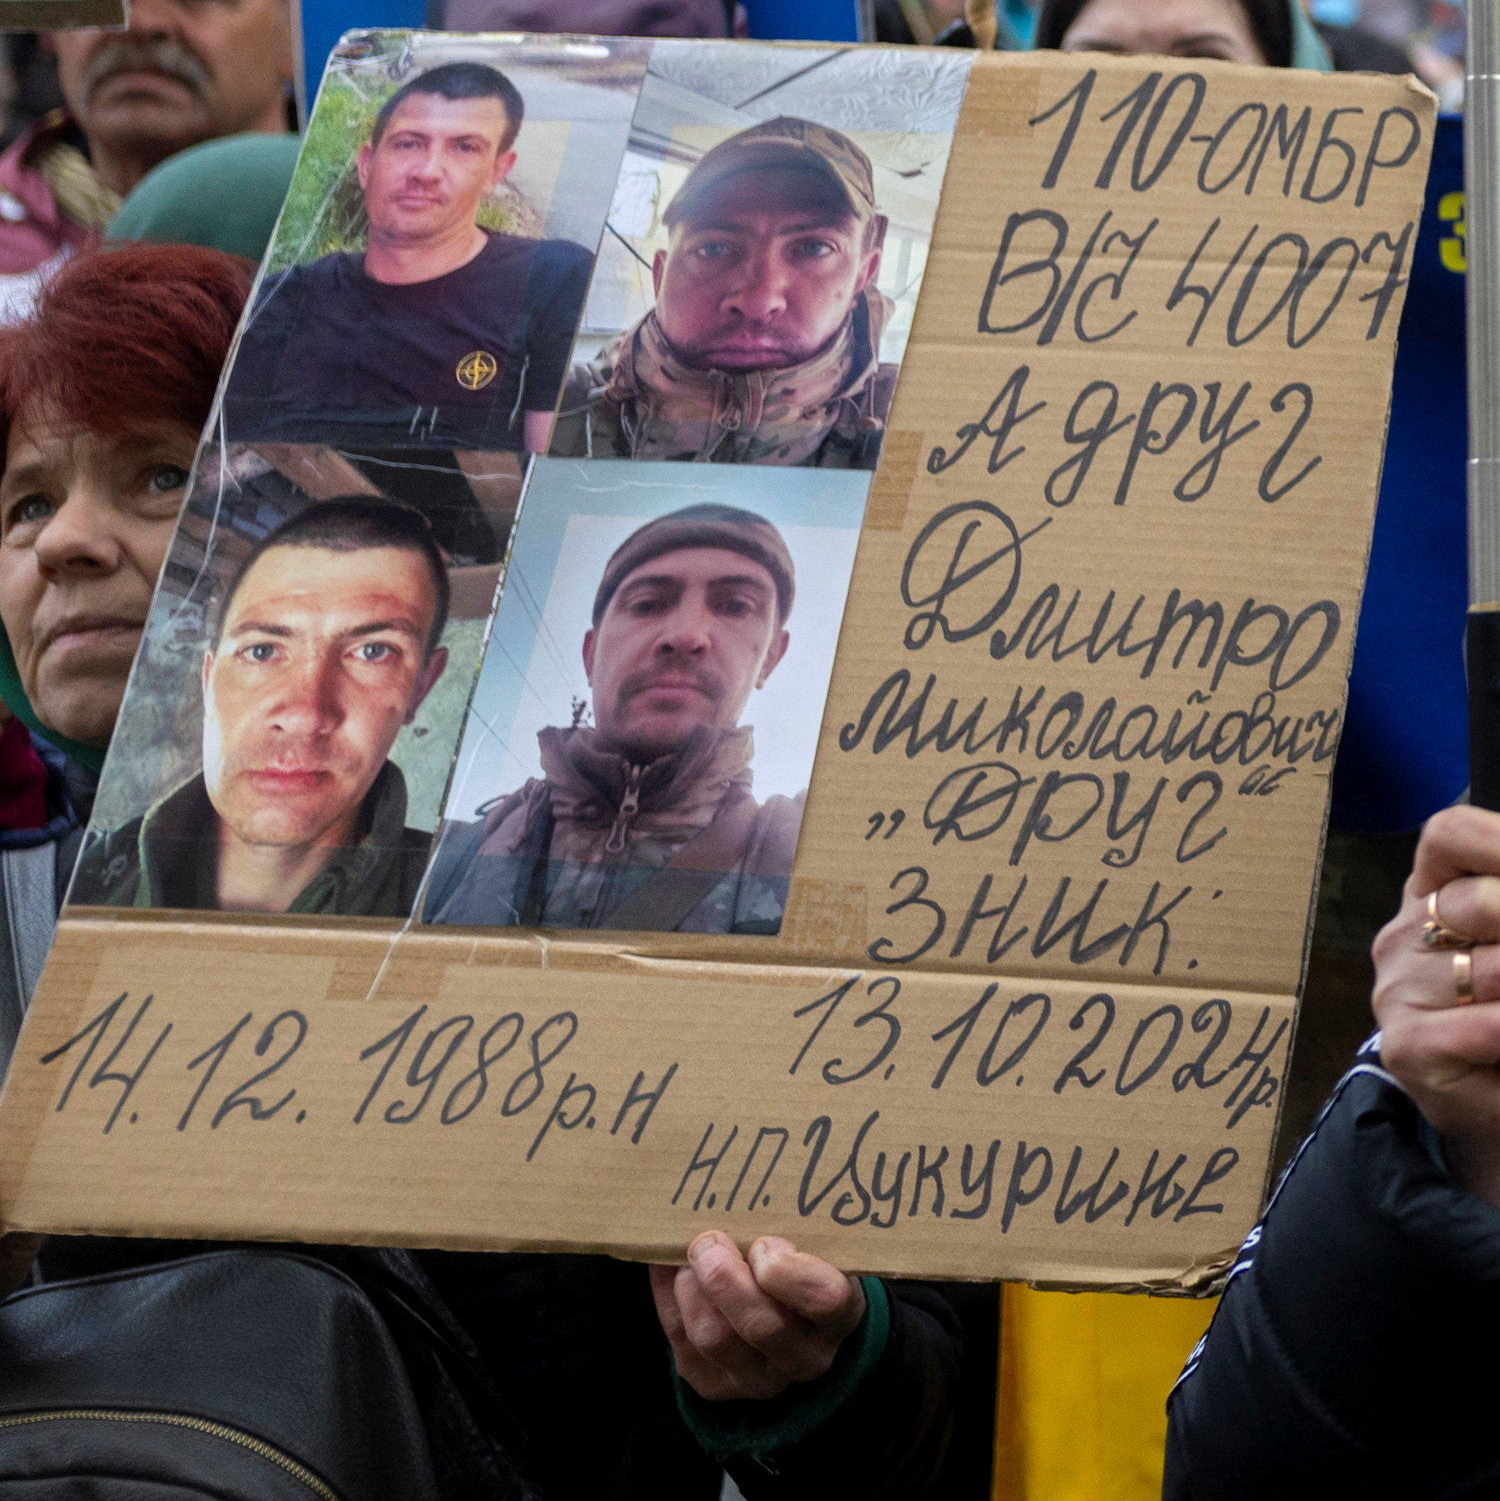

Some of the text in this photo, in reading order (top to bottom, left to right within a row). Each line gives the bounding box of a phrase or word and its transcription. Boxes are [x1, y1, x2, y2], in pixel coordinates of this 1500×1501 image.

[1029, 68, 1422, 208] 110-ОМБР
[900, 500, 1342, 692] Дмитро
[839, 669, 1343, 766] Миколайович
